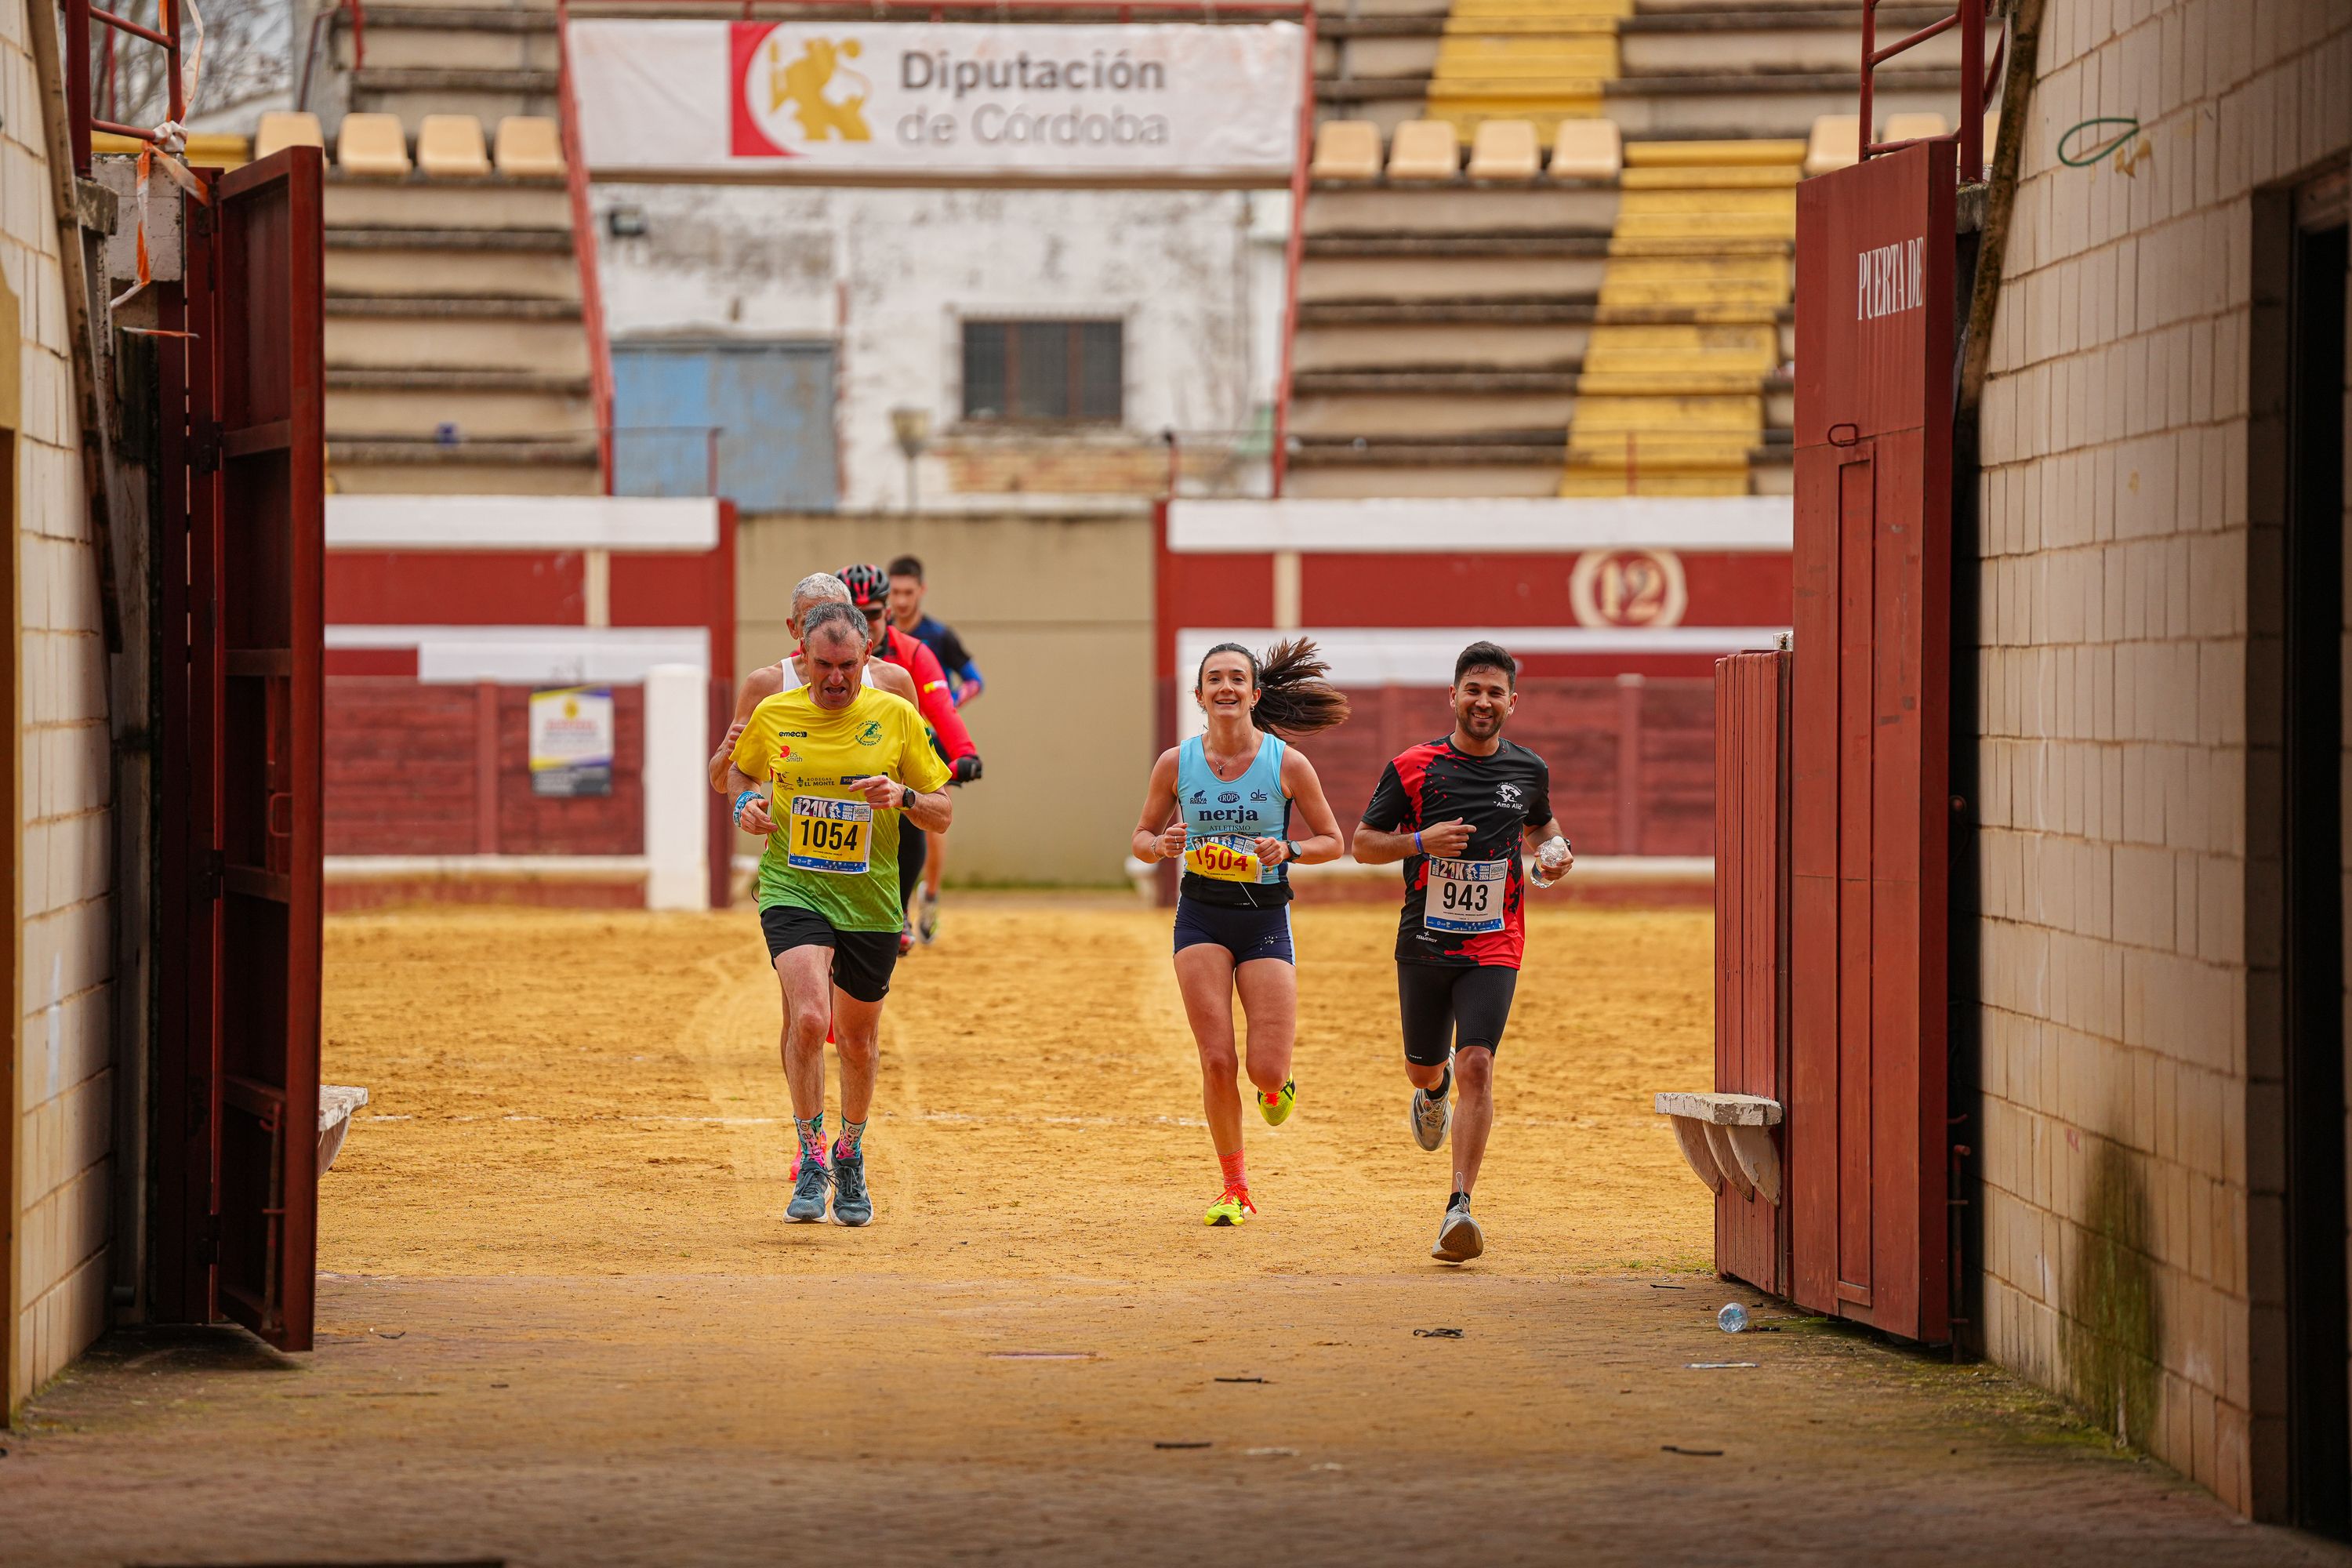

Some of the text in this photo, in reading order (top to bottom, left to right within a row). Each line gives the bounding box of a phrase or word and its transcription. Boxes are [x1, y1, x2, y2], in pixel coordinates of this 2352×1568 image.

[901, 49, 1166, 99] Diputación
[896, 102, 1171, 147] de Córdoba
[1857, 237, 1924, 320] PUERTA DE
[1600, 559, 1662, 620] 12
[801, 799, 828, 818] 21K
[1219, 793, 1239, 802] TROPS
[1199, 805, 1259, 824] nerja
[801, 819, 858, 851] 1054
[1439, 861, 1465, 880] 21K
[1443, 882, 1488, 911] 943
